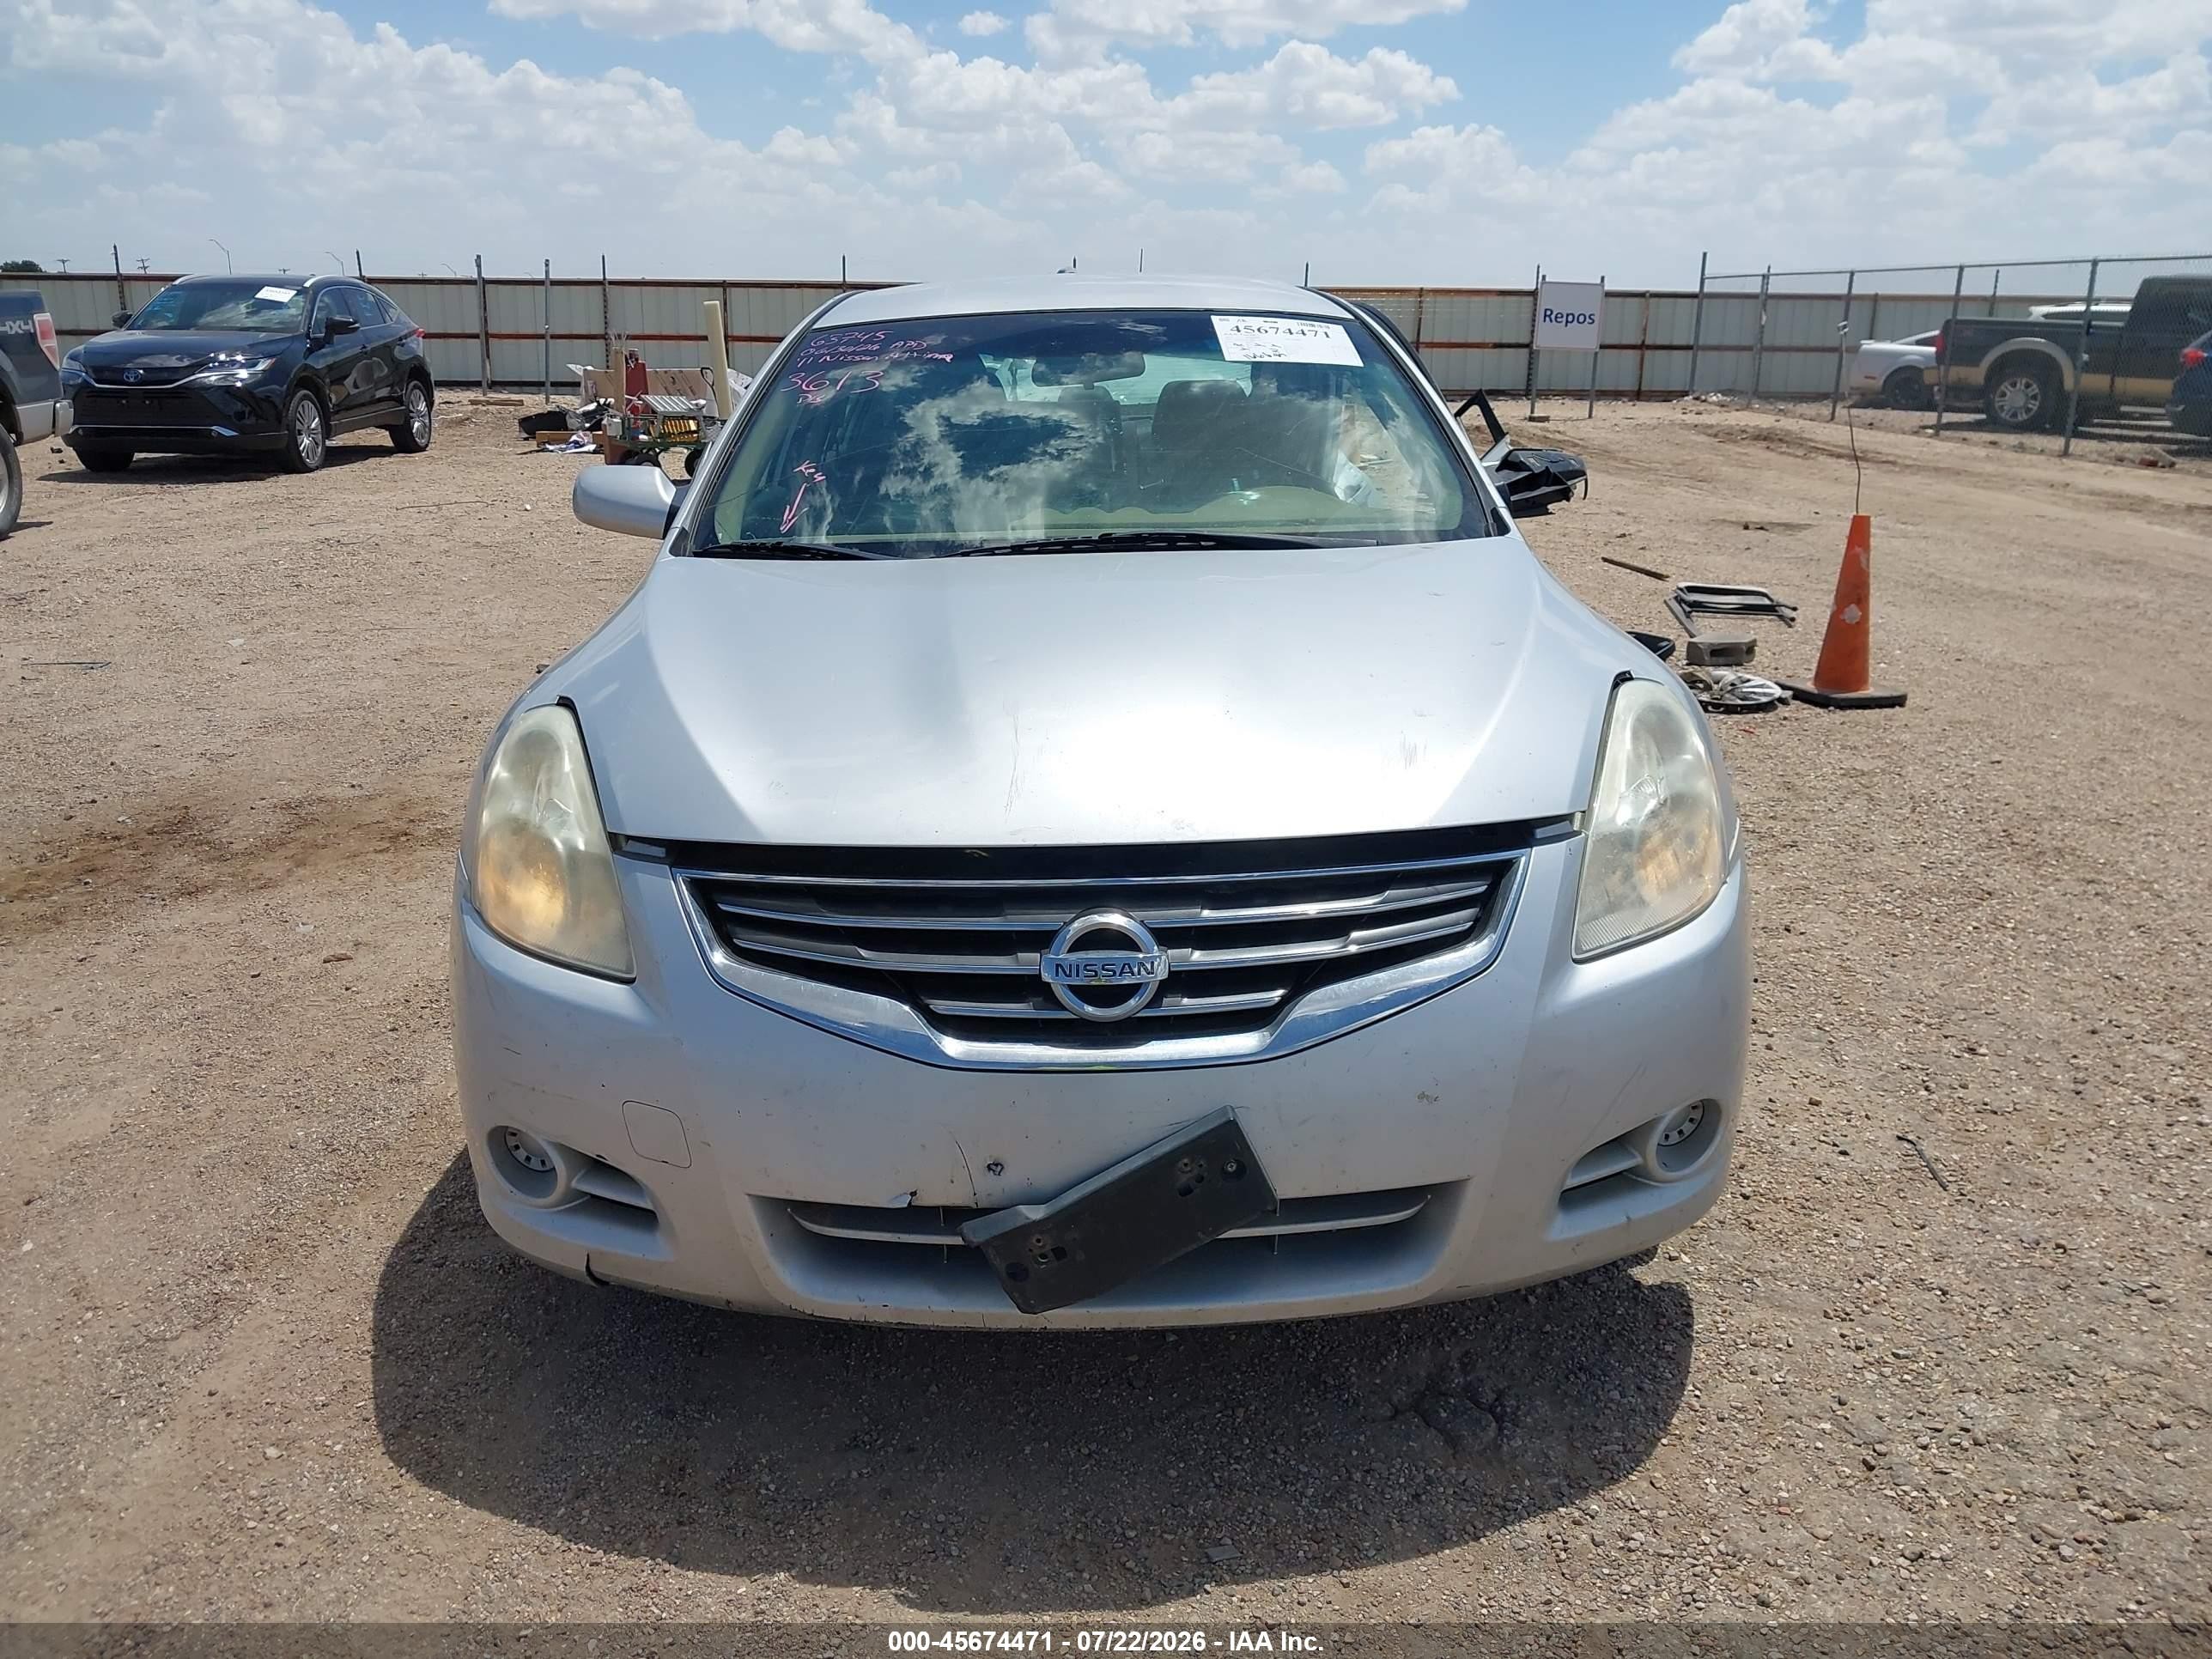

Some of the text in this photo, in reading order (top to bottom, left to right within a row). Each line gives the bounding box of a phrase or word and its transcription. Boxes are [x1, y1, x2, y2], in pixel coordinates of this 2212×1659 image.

[1543, 308, 1595, 327] Repos
[1230, 325, 1331, 339] 45674471
[781, 370, 884, 393] 3613
[1054, 960, 1155, 978] NISSAN
